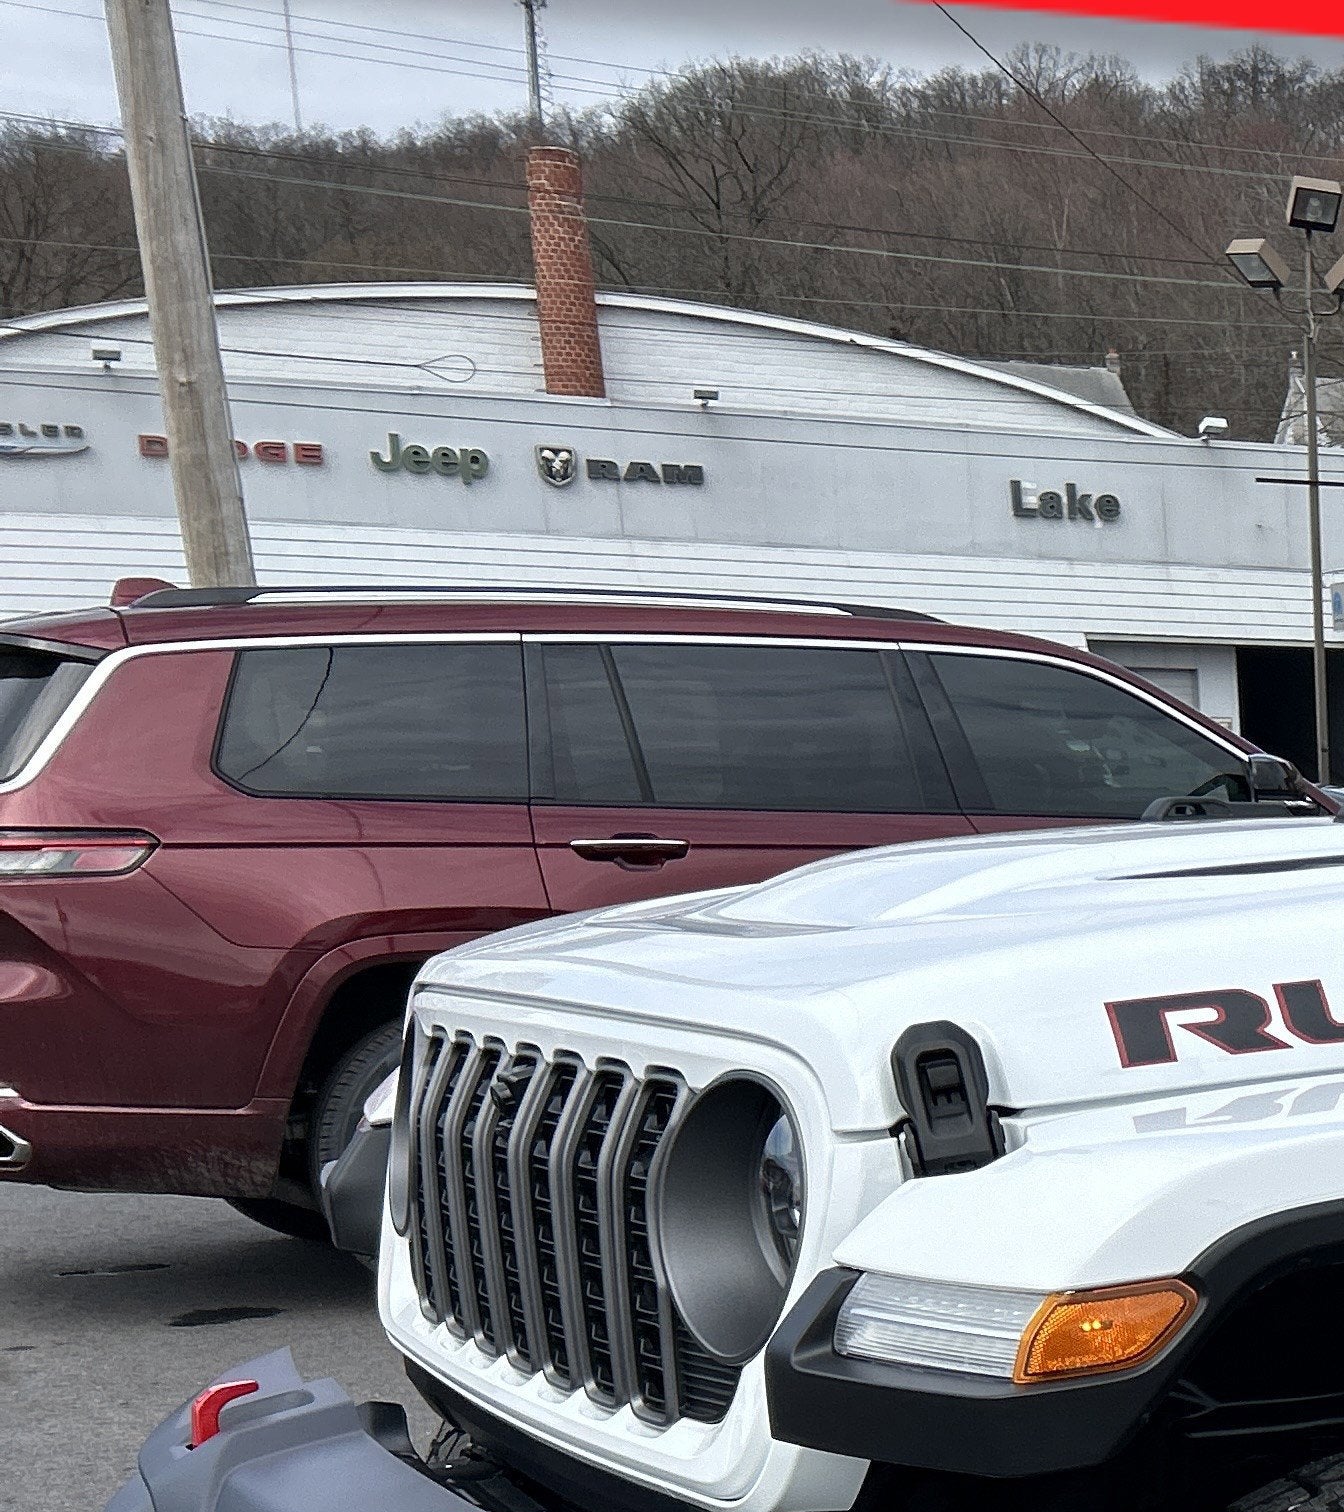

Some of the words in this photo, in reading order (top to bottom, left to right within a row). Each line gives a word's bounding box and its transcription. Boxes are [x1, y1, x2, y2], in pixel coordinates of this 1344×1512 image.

[138, 433, 323, 464] DGE
[370, 432, 489, 484] Jeep
[586, 458, 705, 486] RAM
[1009, 479, 1121, 523] Lake
